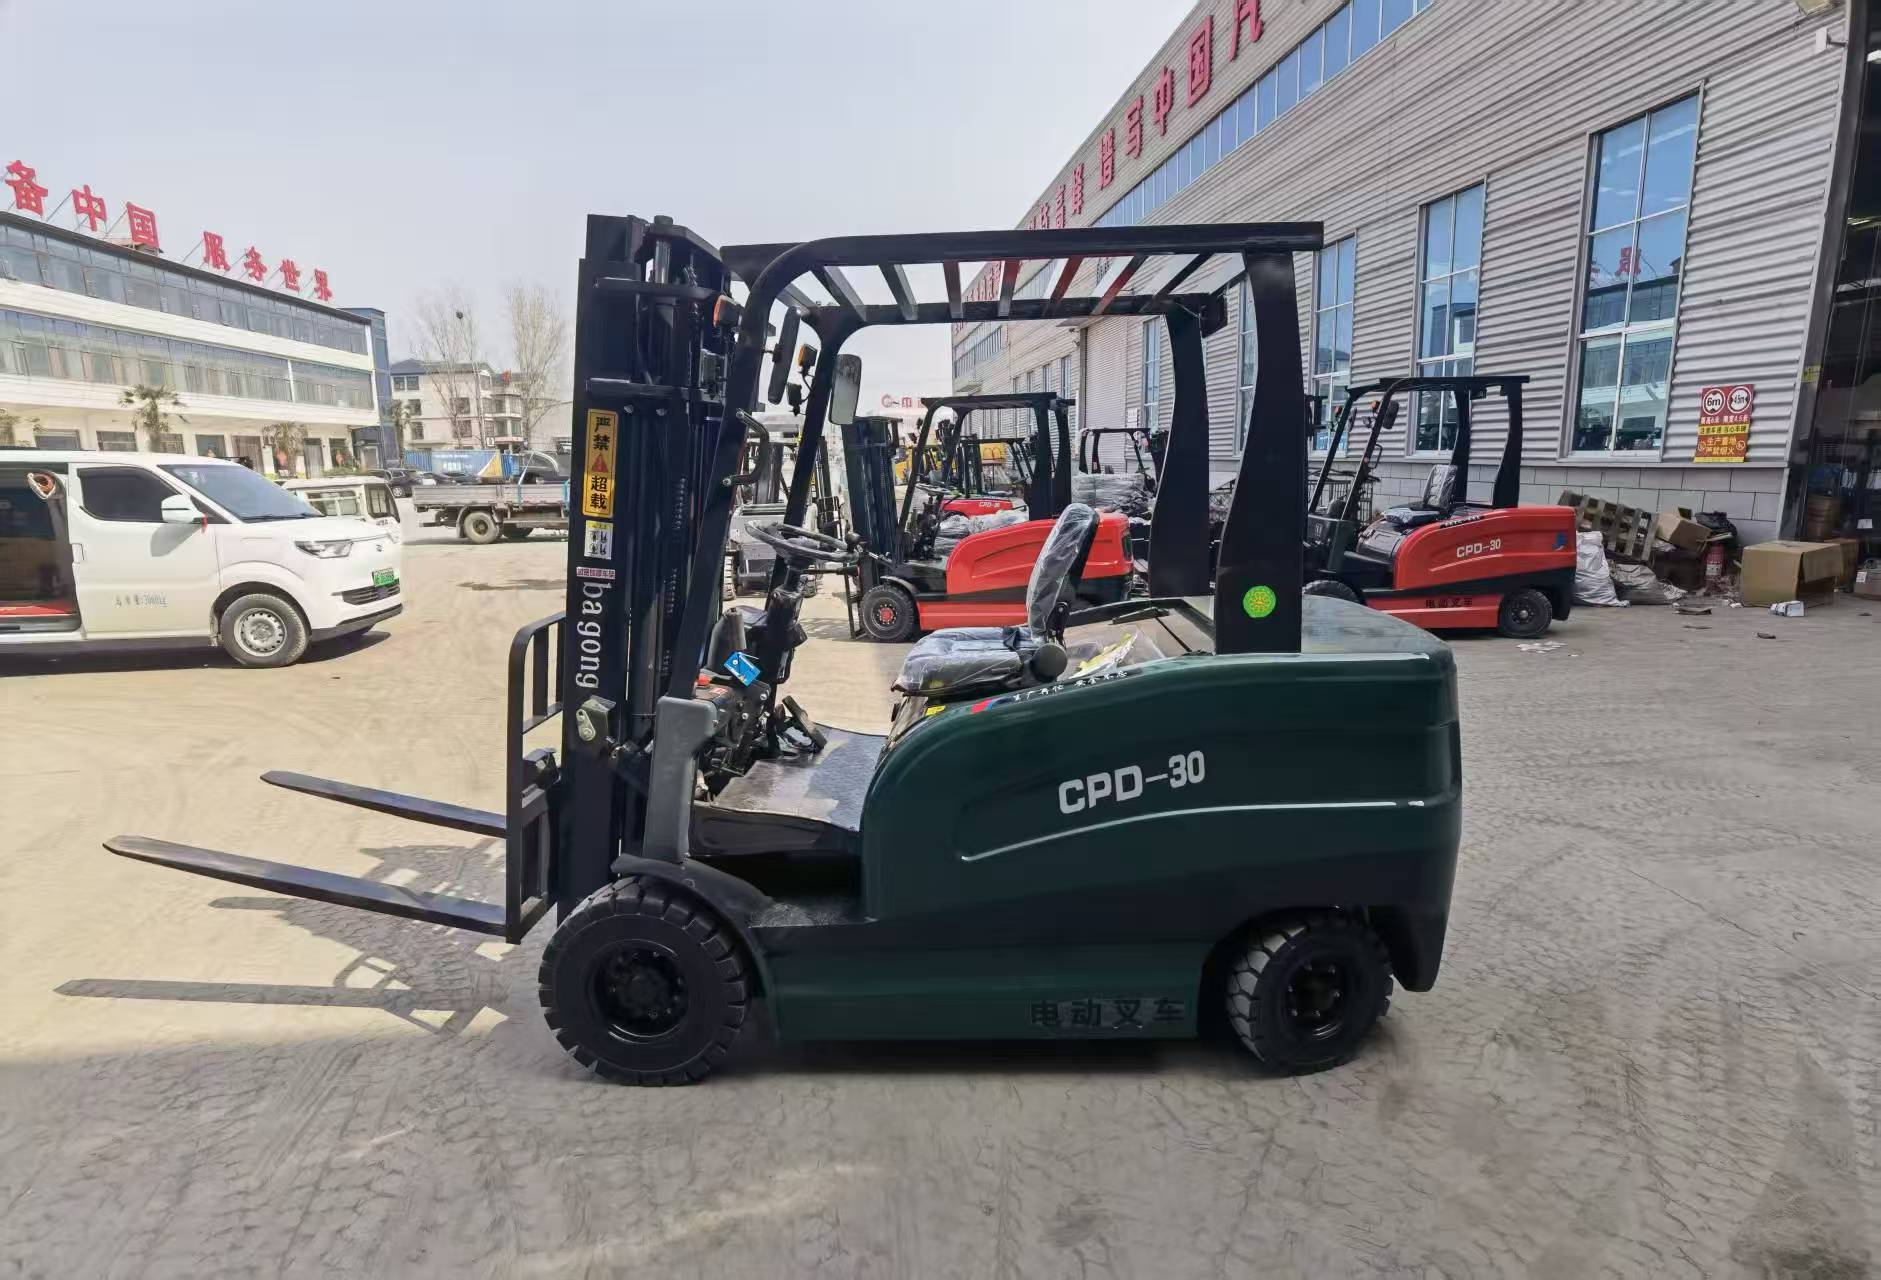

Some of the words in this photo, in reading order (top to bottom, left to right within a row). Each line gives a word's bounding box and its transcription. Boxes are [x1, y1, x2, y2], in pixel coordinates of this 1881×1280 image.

[5, 160, 160, 249] 备中国
[203, 231, 333, 302] 服务世界
[1707, 397, 1721, 407] 6m
[1708, 436, 1737, 446] 生产重地
[1456, 539, 1501, 557] CPD-30
[575, 581, 613, 689] bagong
[1058, 750, 1206, 815] CPD-30
[1031, 997, 1186, 1029] 电动叉车
